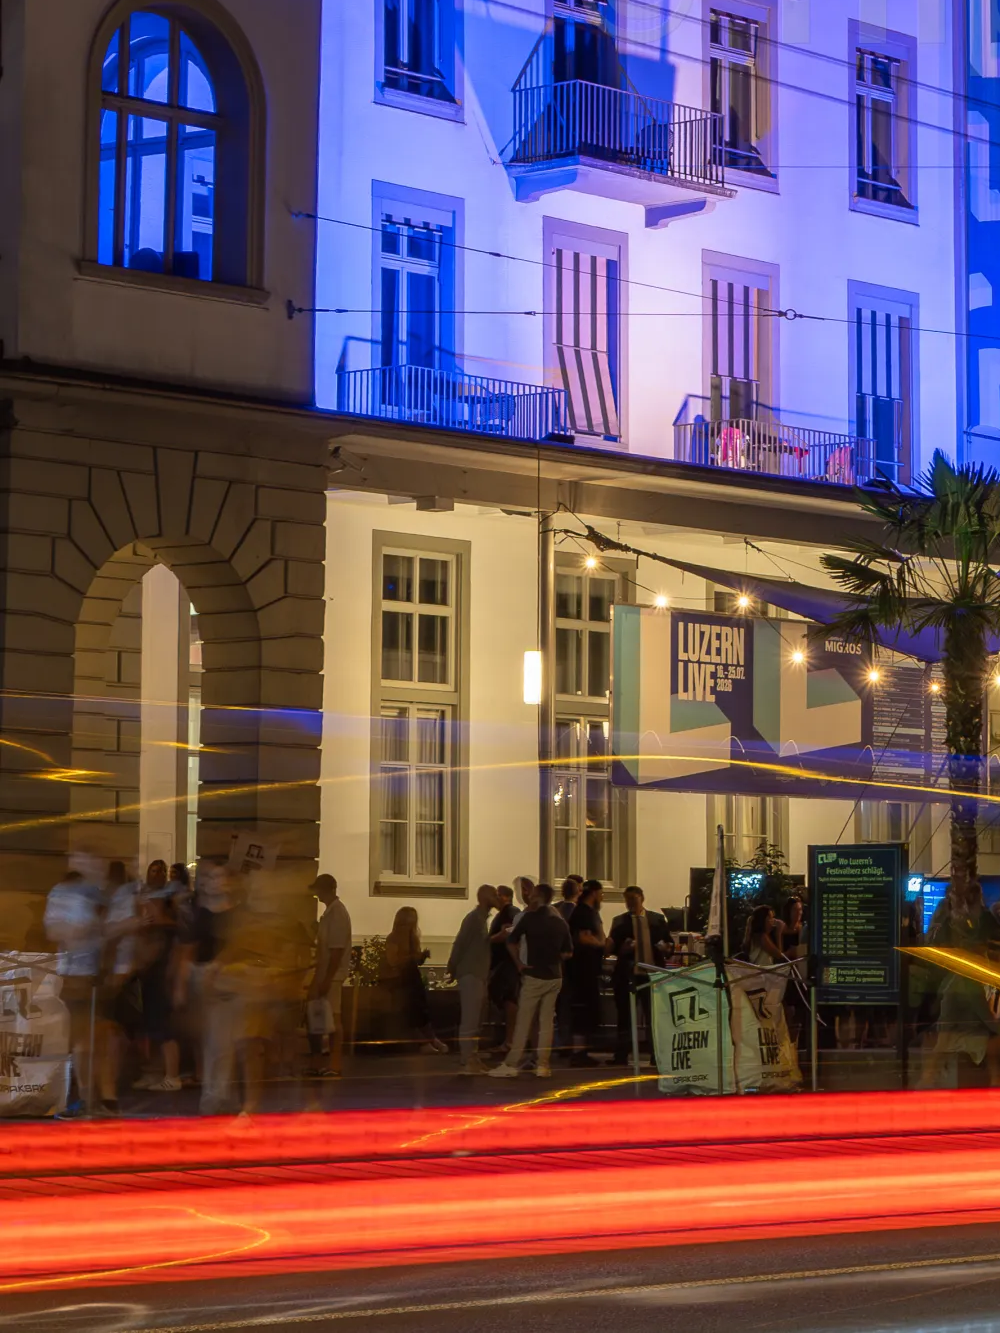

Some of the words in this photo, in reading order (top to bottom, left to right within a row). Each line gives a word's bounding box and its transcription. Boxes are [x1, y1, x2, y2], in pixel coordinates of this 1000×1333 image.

[678, 622, 745, 665] LUZERN
[678, 662, 716, 703] LIVE
[716, 679, 732, 692] 2026
[672, 1030, 709, 1052] LUZERN
[671, 1050, 692, 1071] LIVE
